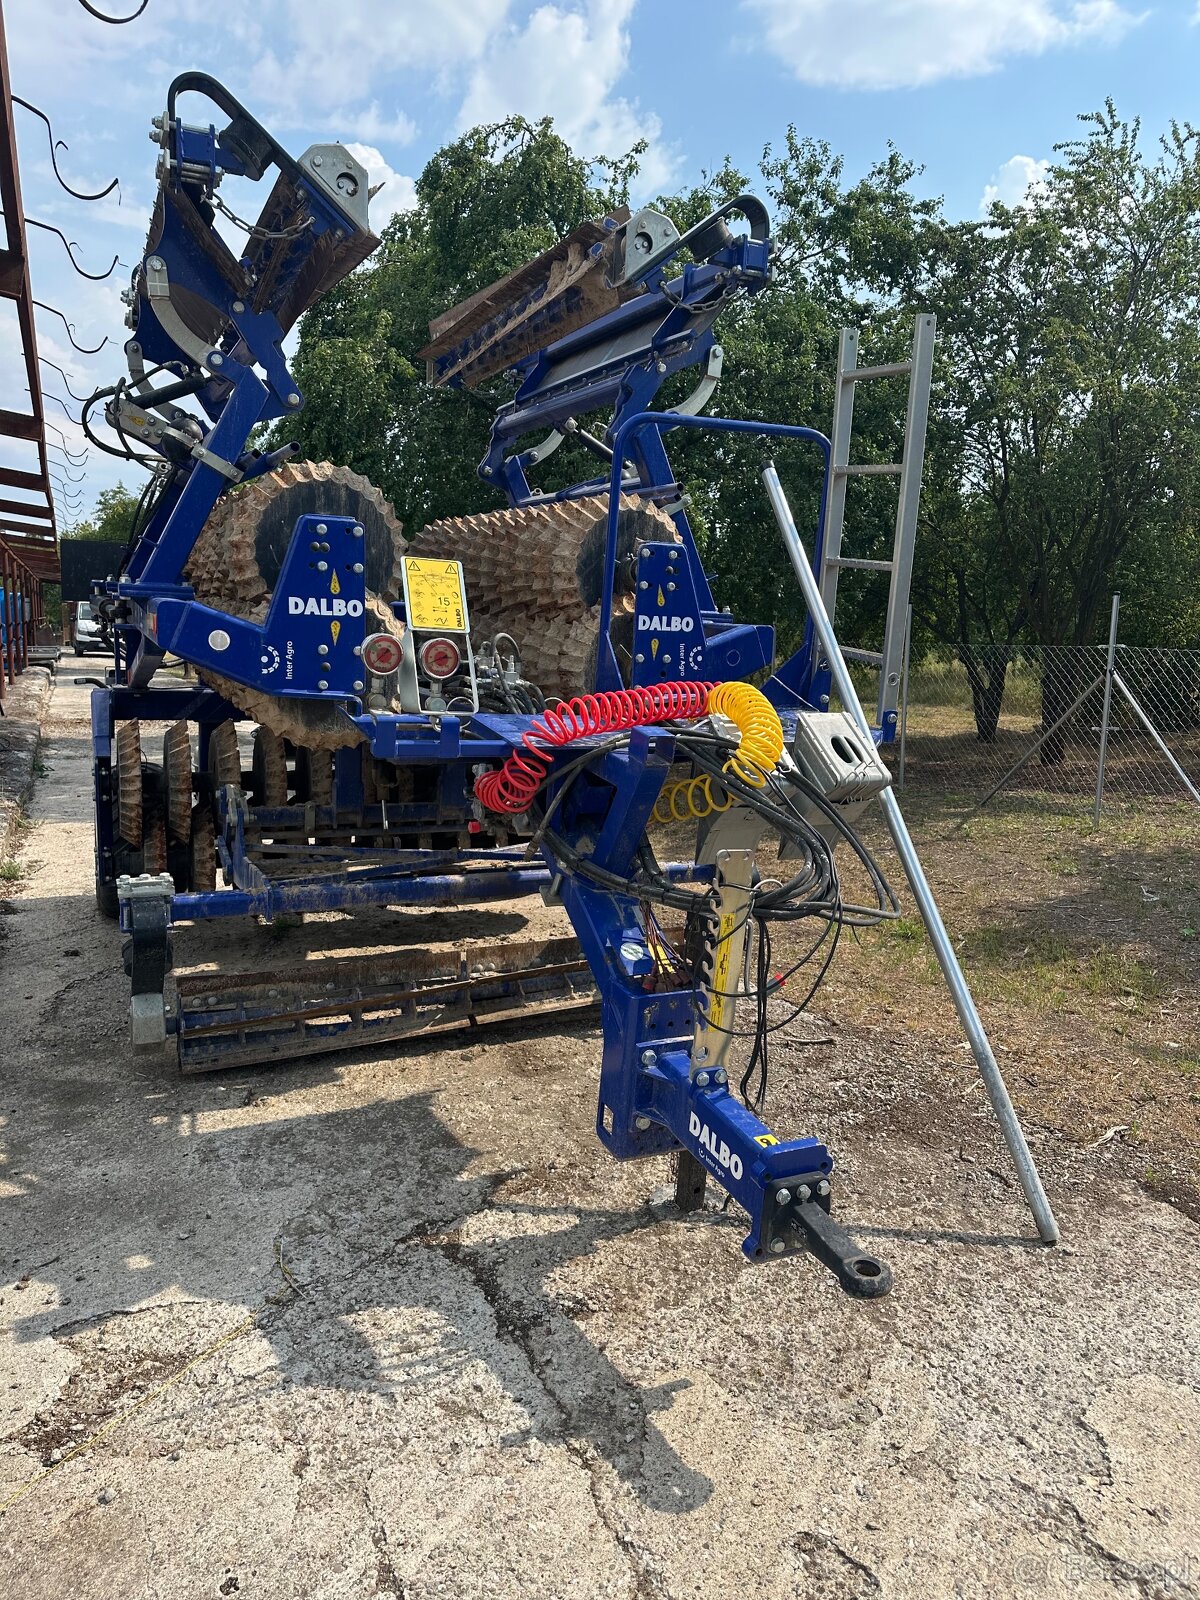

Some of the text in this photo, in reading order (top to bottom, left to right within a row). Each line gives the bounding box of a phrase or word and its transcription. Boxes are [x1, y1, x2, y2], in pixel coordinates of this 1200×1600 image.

[289, 597, 363, 617] DALBO
[438, 596, 450, 606] 15
[638, 615, 693, 631] DALBO
[286, 640, 295, 660] Agro
[689, 1111, 743, 1179] DALBO
